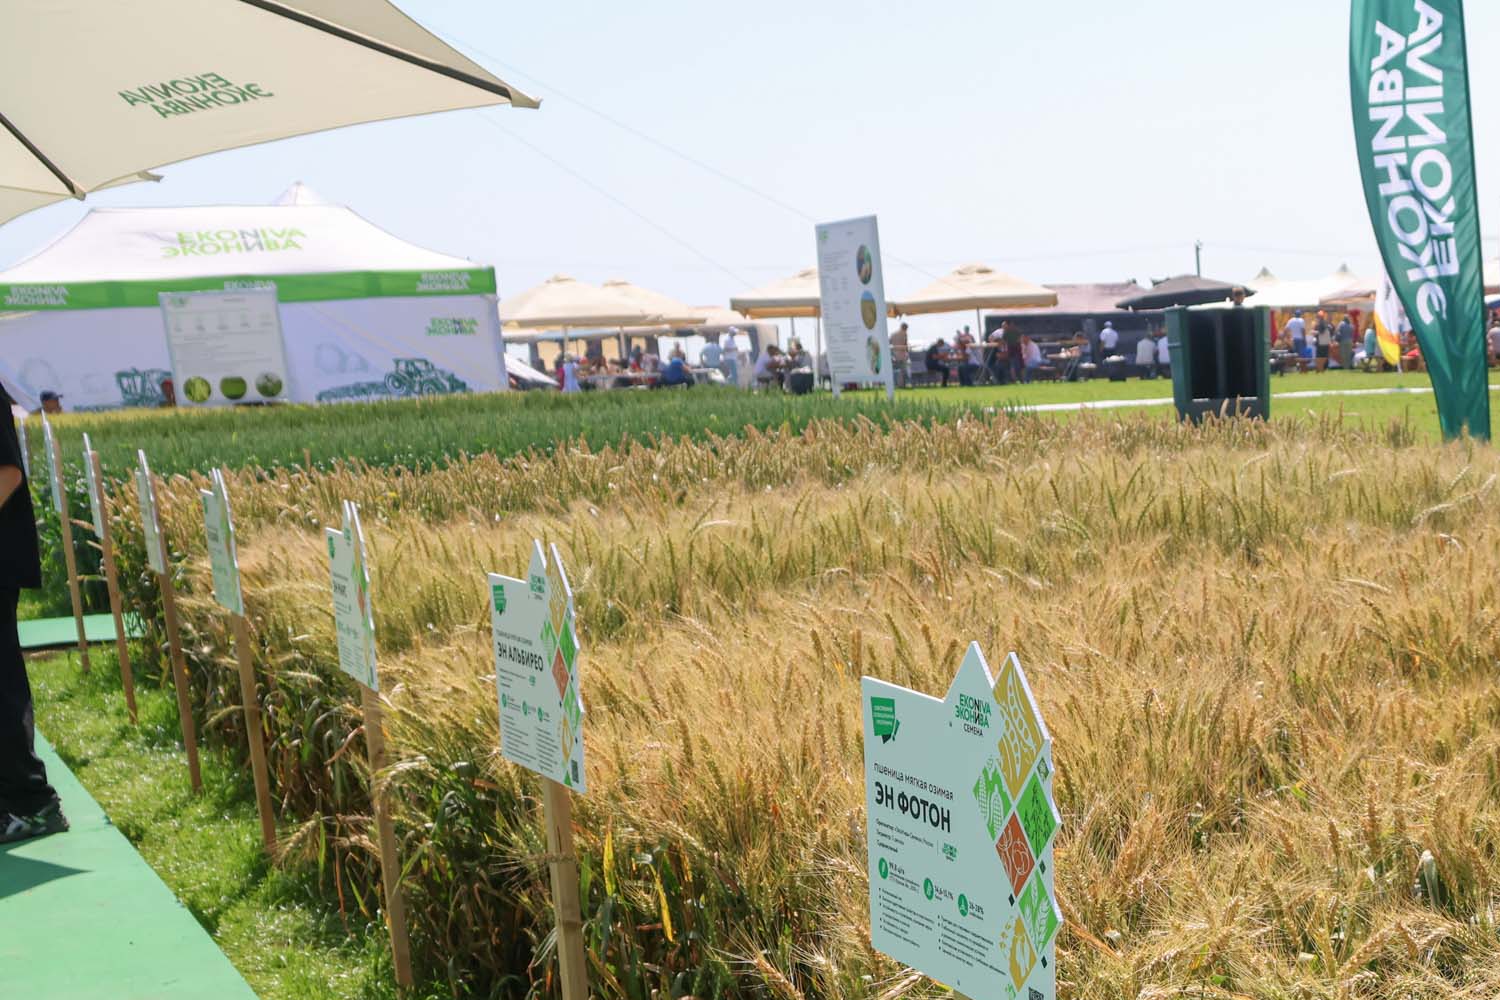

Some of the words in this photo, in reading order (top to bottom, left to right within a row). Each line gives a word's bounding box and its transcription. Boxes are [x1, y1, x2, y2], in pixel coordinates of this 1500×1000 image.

[176, 228, 307, 244] EKONIVA
[160, 239, 303, 258] ЭКОНИВА
[959, 693, 992, 716] EKONIVA
[955, 705, 990, 728] ЭКОНИВА
[963, 723, 984, 737] СЕМЕНА
[874, 762, 904, 782] пшеница
[905, 774, 928, 790] мягкая
[929, 784, 954, 801] озимая
[875, 781, 894, 810] ЭН
[897, 791, 951, 833] ФОТОН
